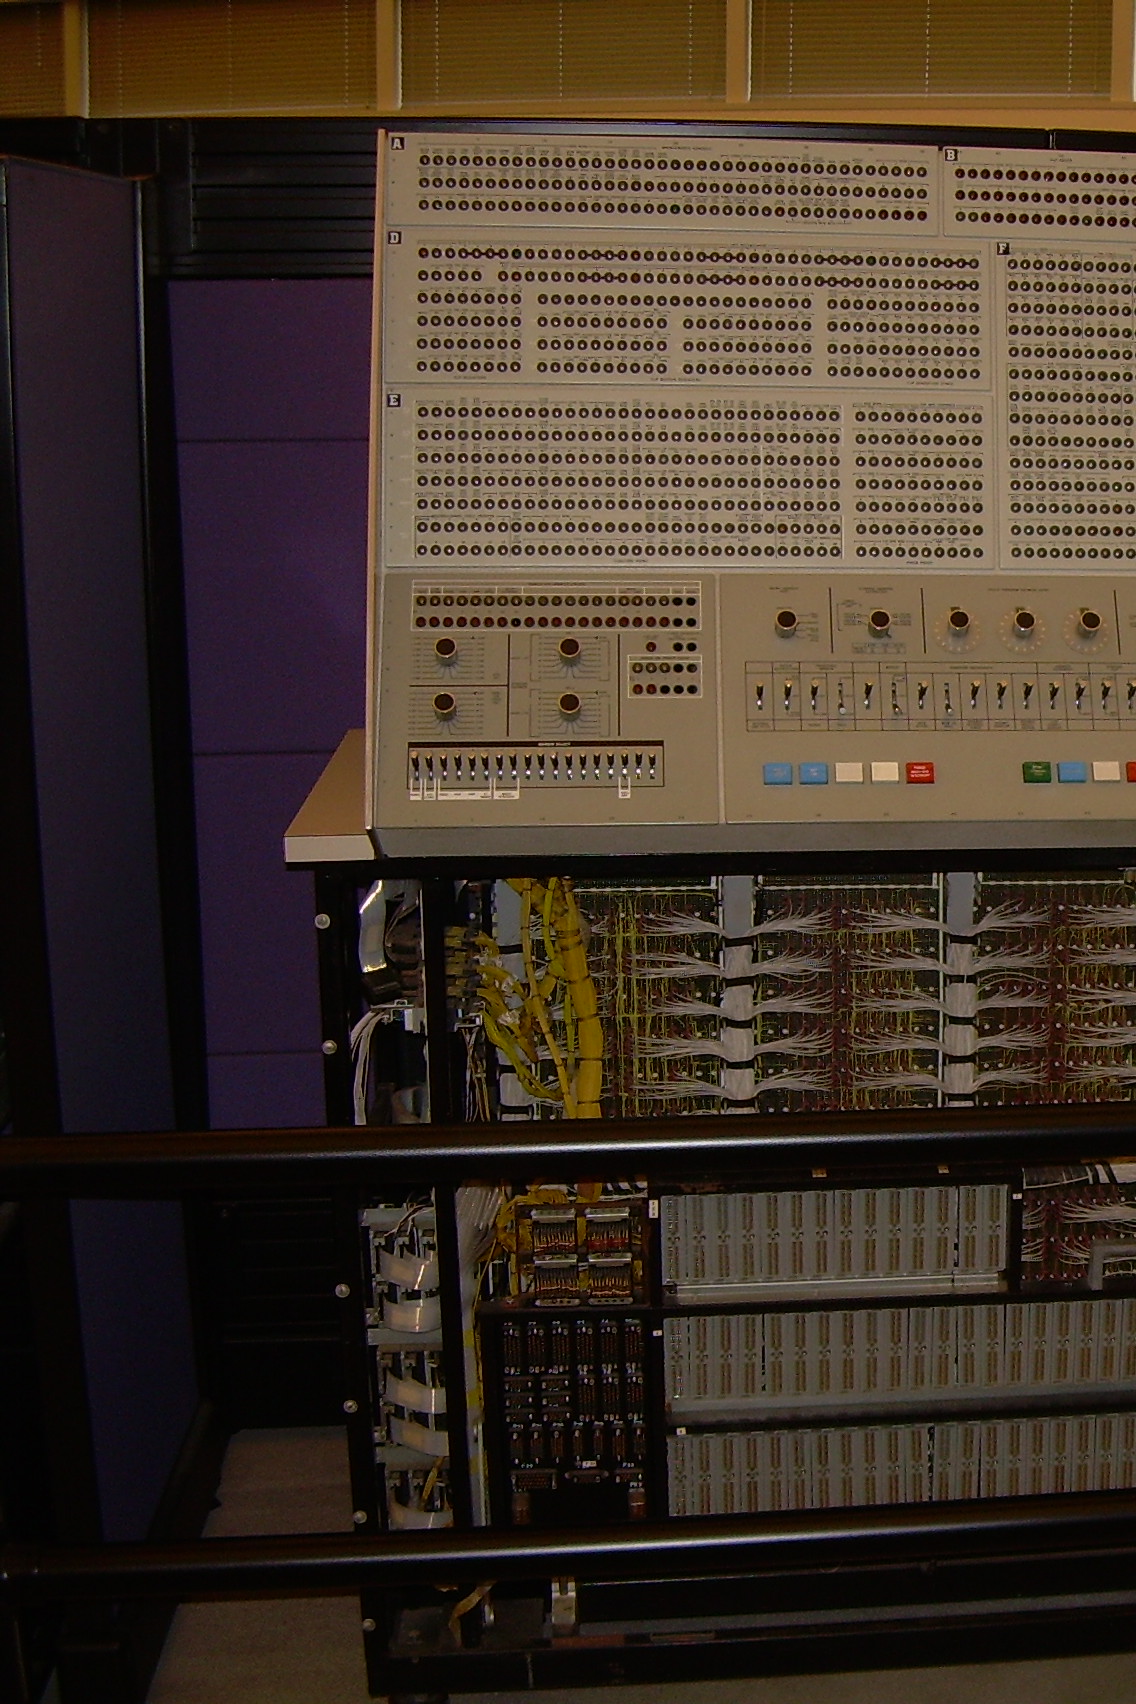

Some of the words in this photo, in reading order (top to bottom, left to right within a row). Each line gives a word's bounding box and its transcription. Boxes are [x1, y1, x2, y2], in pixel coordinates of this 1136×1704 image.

[392, 138, 402, 149] A
[946, 150, 955, 160] B
[390, 232, 399, 243] D
[999, 243, 1007, 254] F
[389, 395, 398, 406] E
